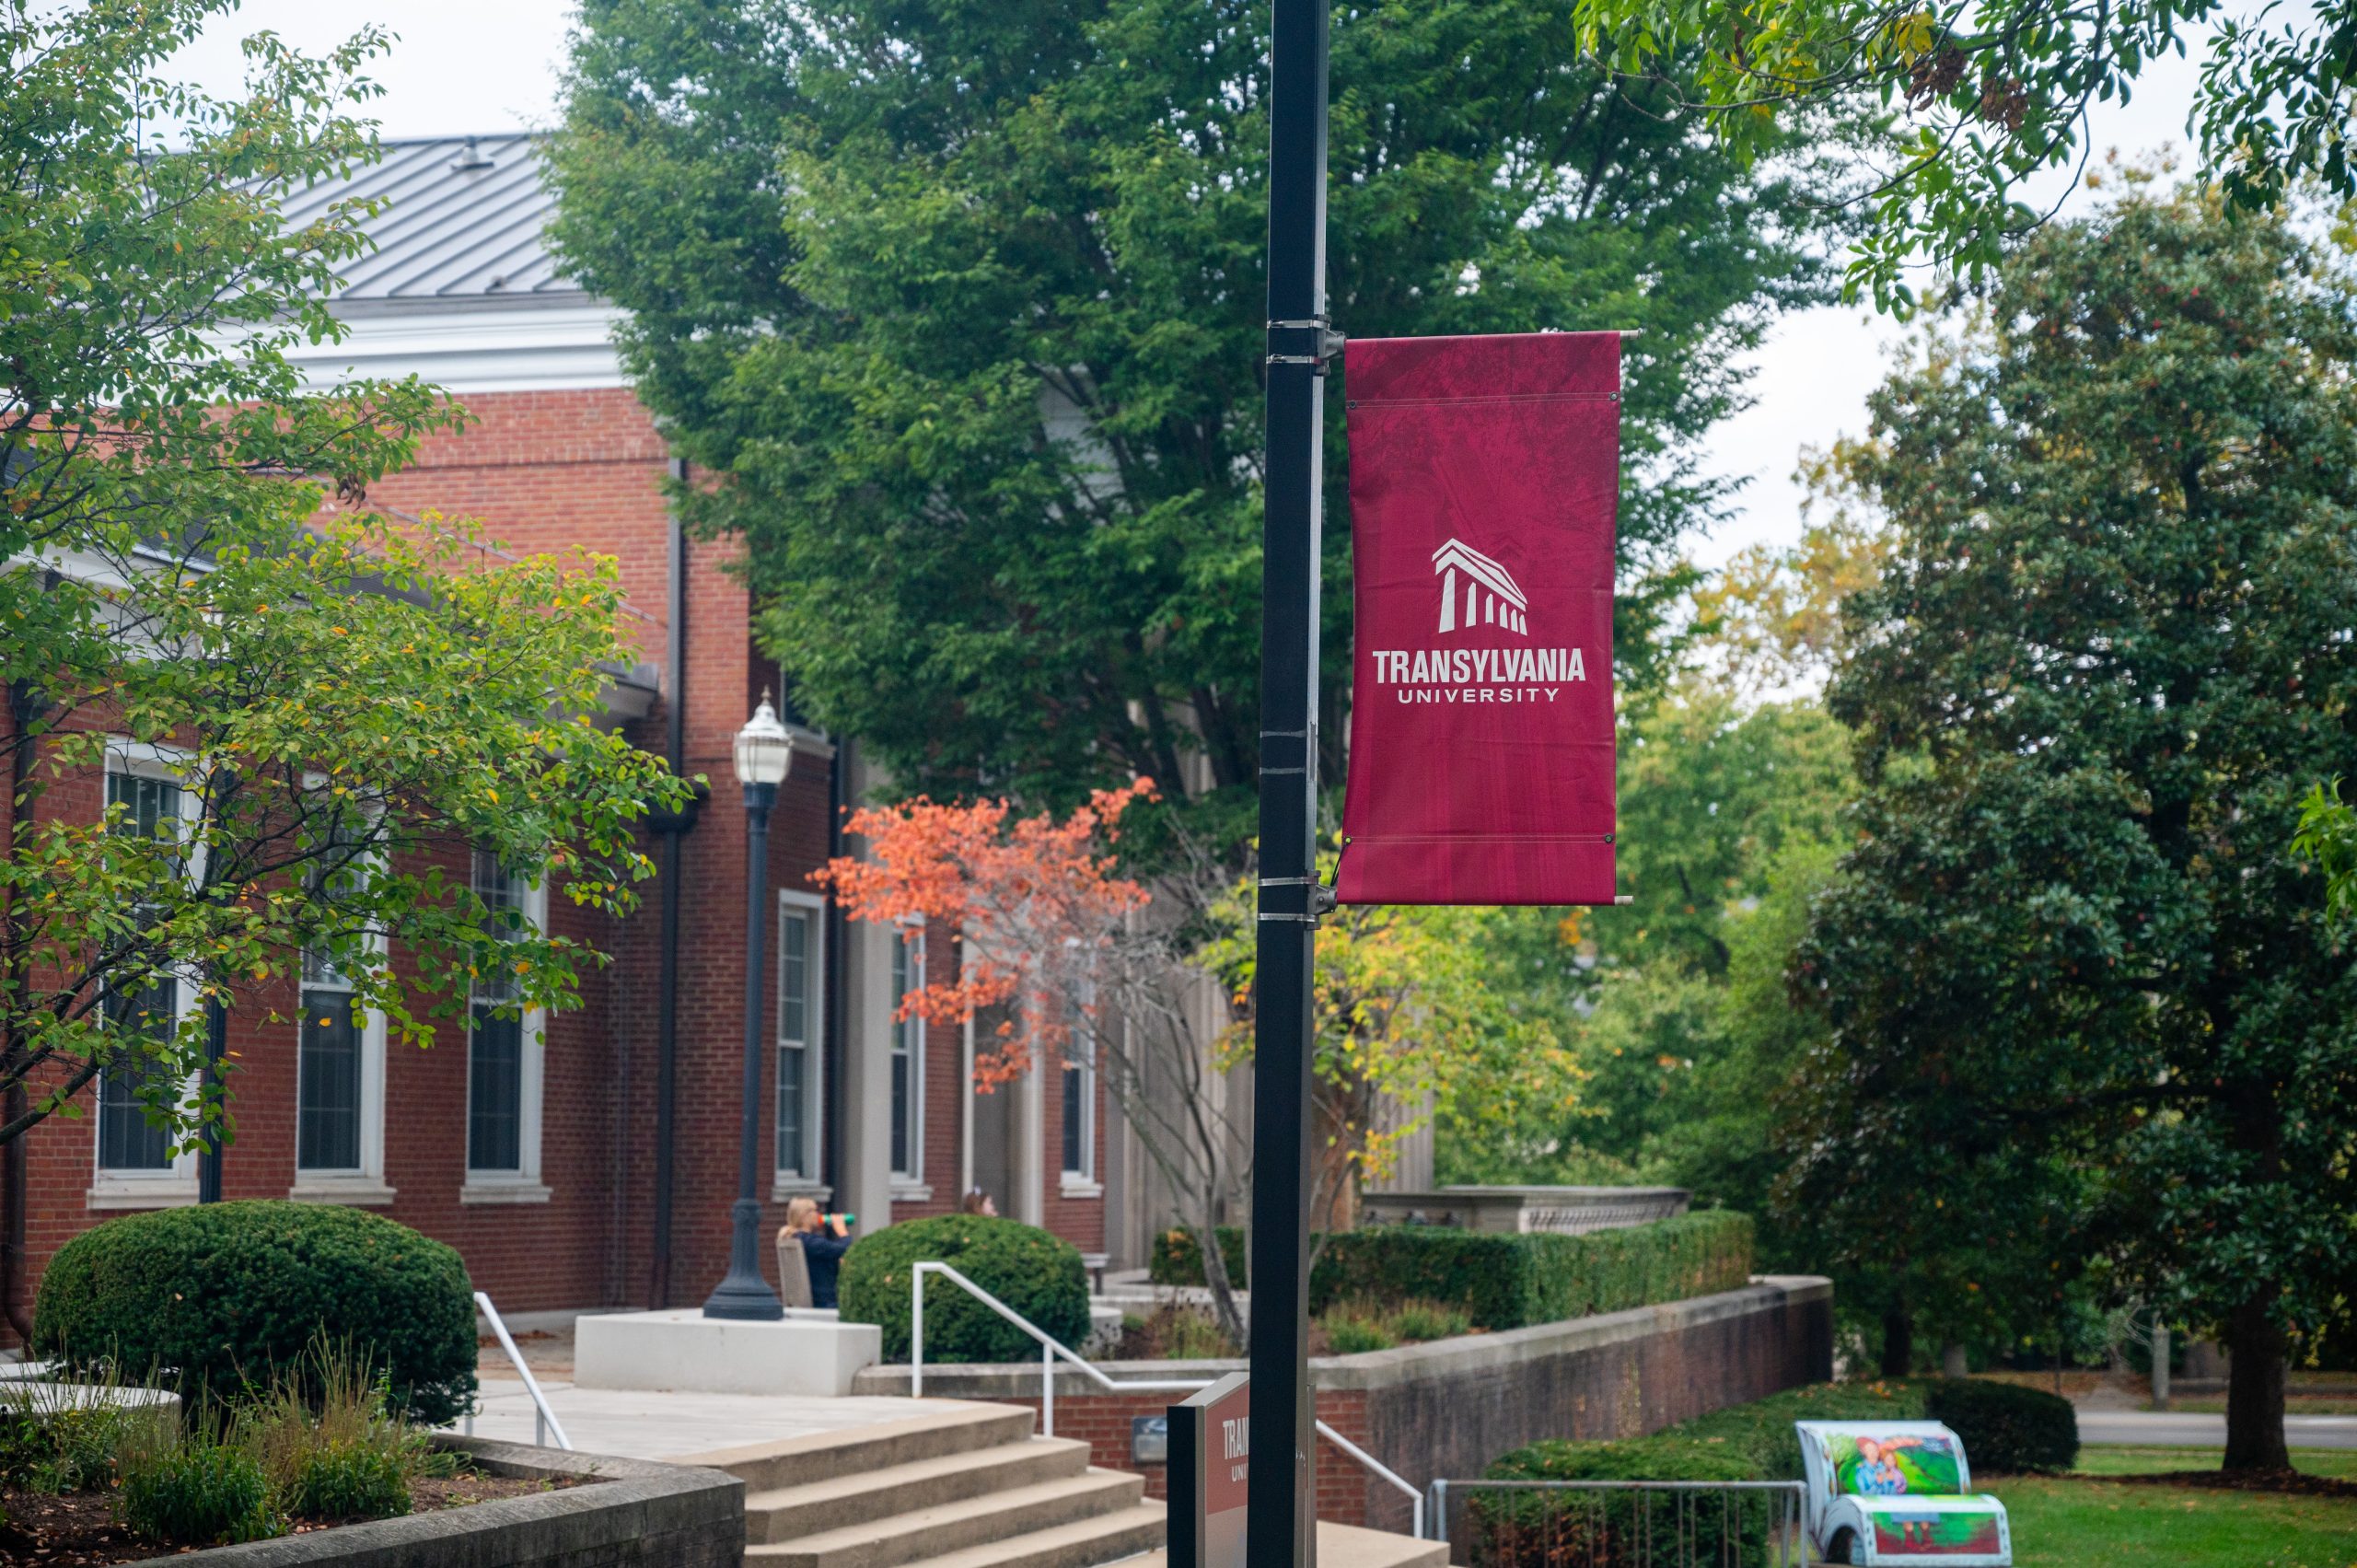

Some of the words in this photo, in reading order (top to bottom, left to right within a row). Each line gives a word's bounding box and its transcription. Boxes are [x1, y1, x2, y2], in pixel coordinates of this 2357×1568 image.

[1373, 648, 1585, 683] TRANSYLVANIA
[1398, 688, 1560, 704] UNIVERSITY
[1223, 1416, 1249, 1460] TRAN
[1232, 1463, 1249, 1482] UNI
